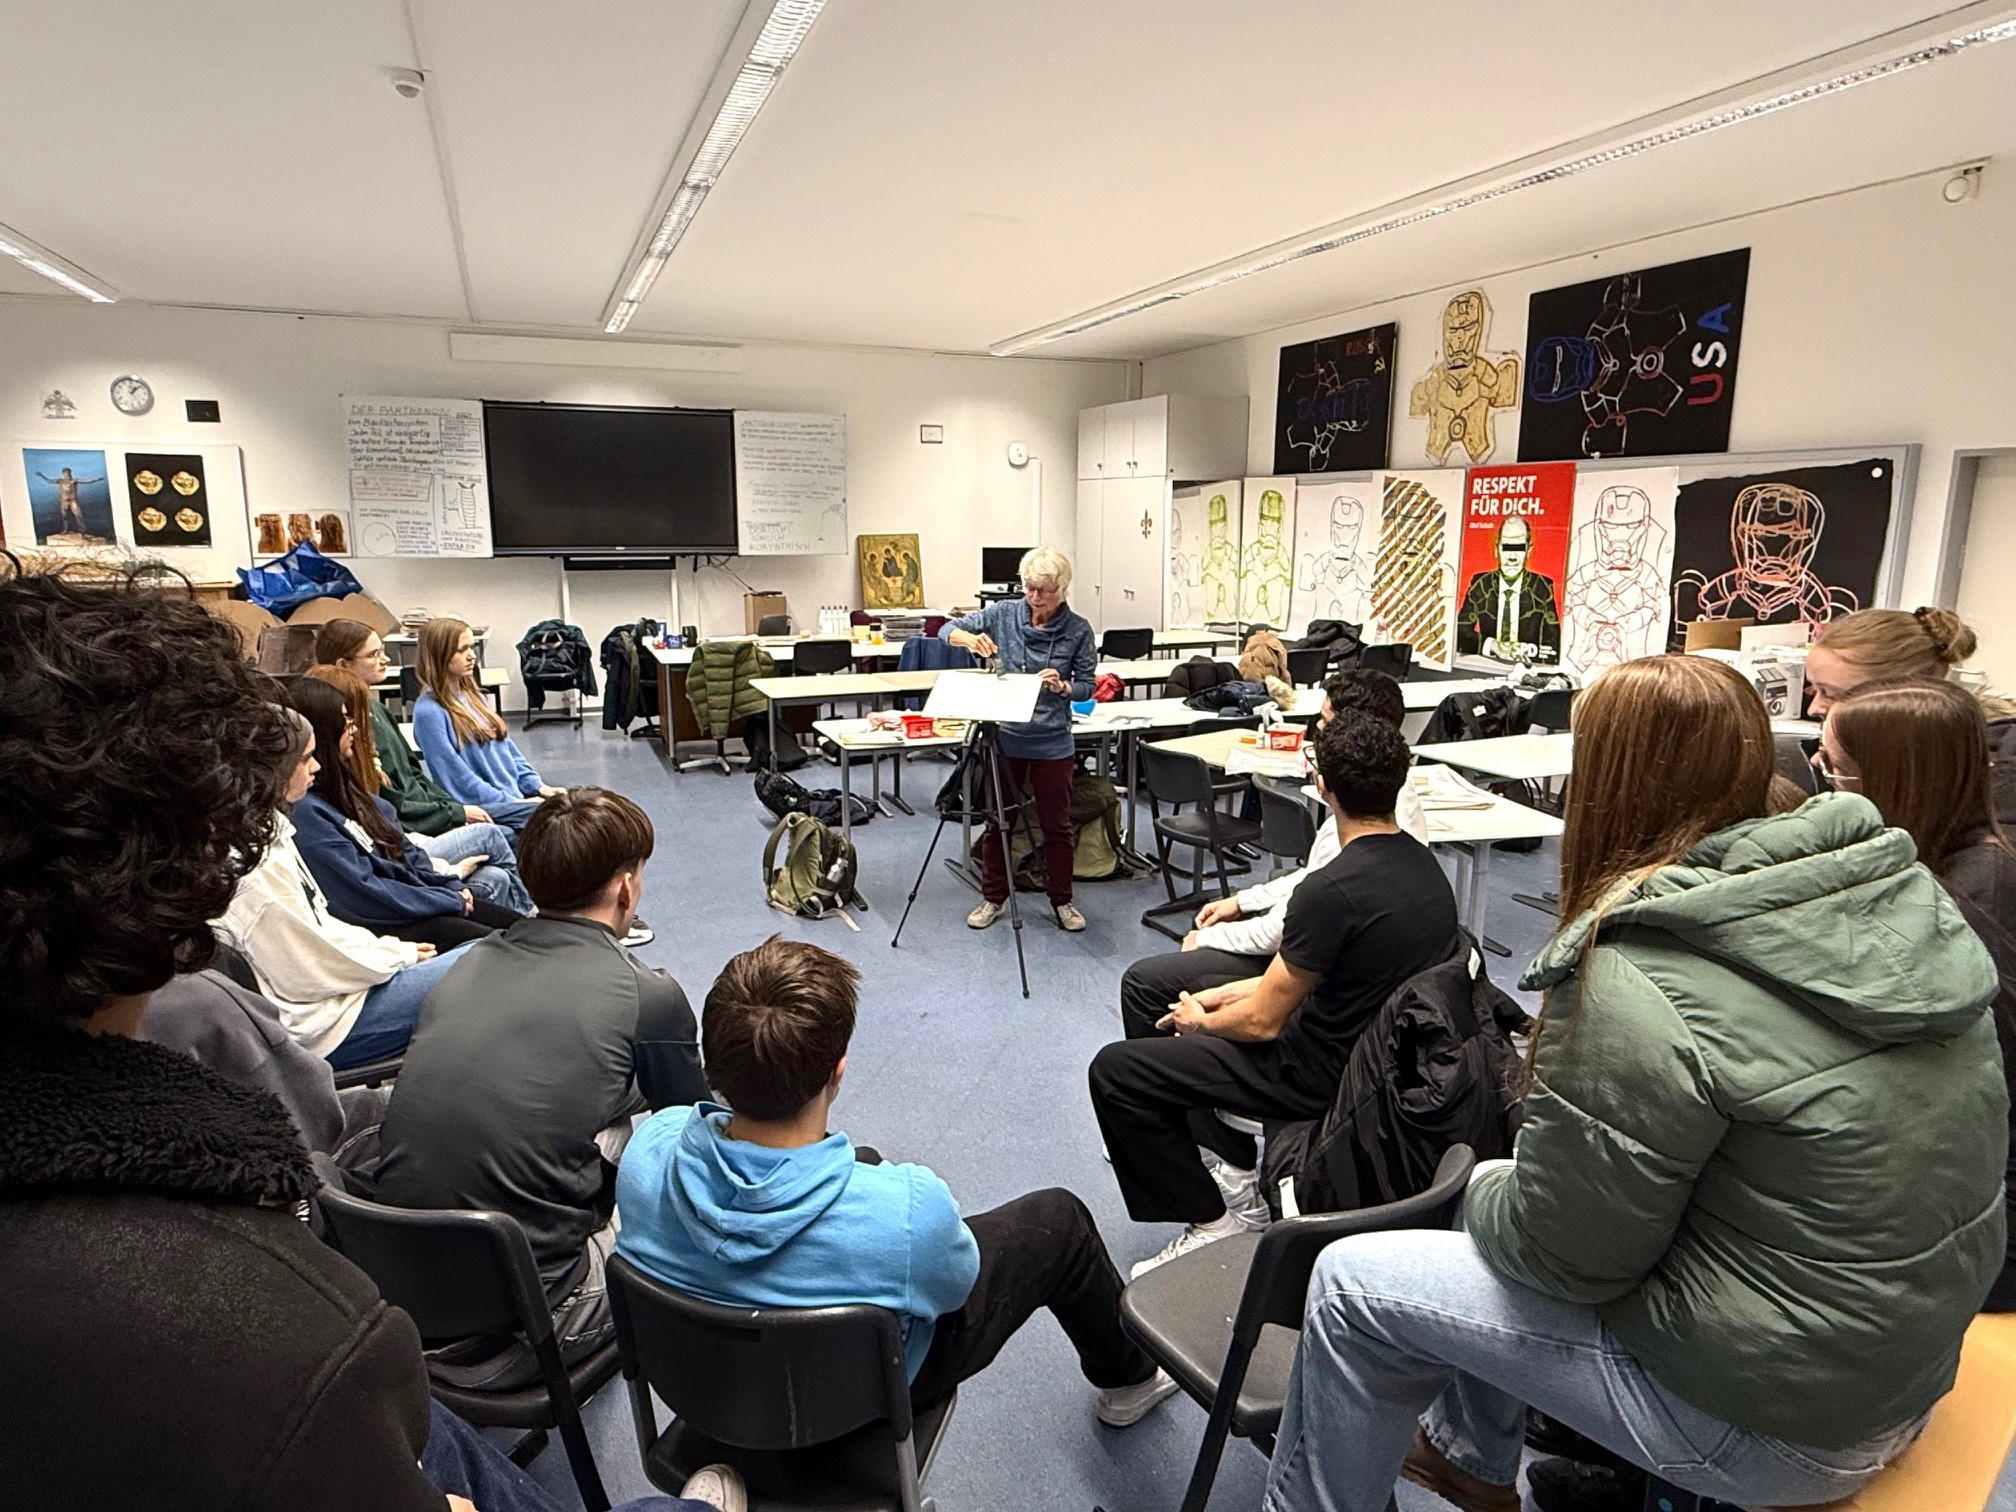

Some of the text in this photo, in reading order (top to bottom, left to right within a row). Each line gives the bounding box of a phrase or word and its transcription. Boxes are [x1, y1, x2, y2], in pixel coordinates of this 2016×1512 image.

[1687, 302, 1732, 405] USA
[351, 404, 374, 415] DER
[1472, 475, 1537, 494] RESPEKT
[1470, 495, 1499, 515] FÜR
